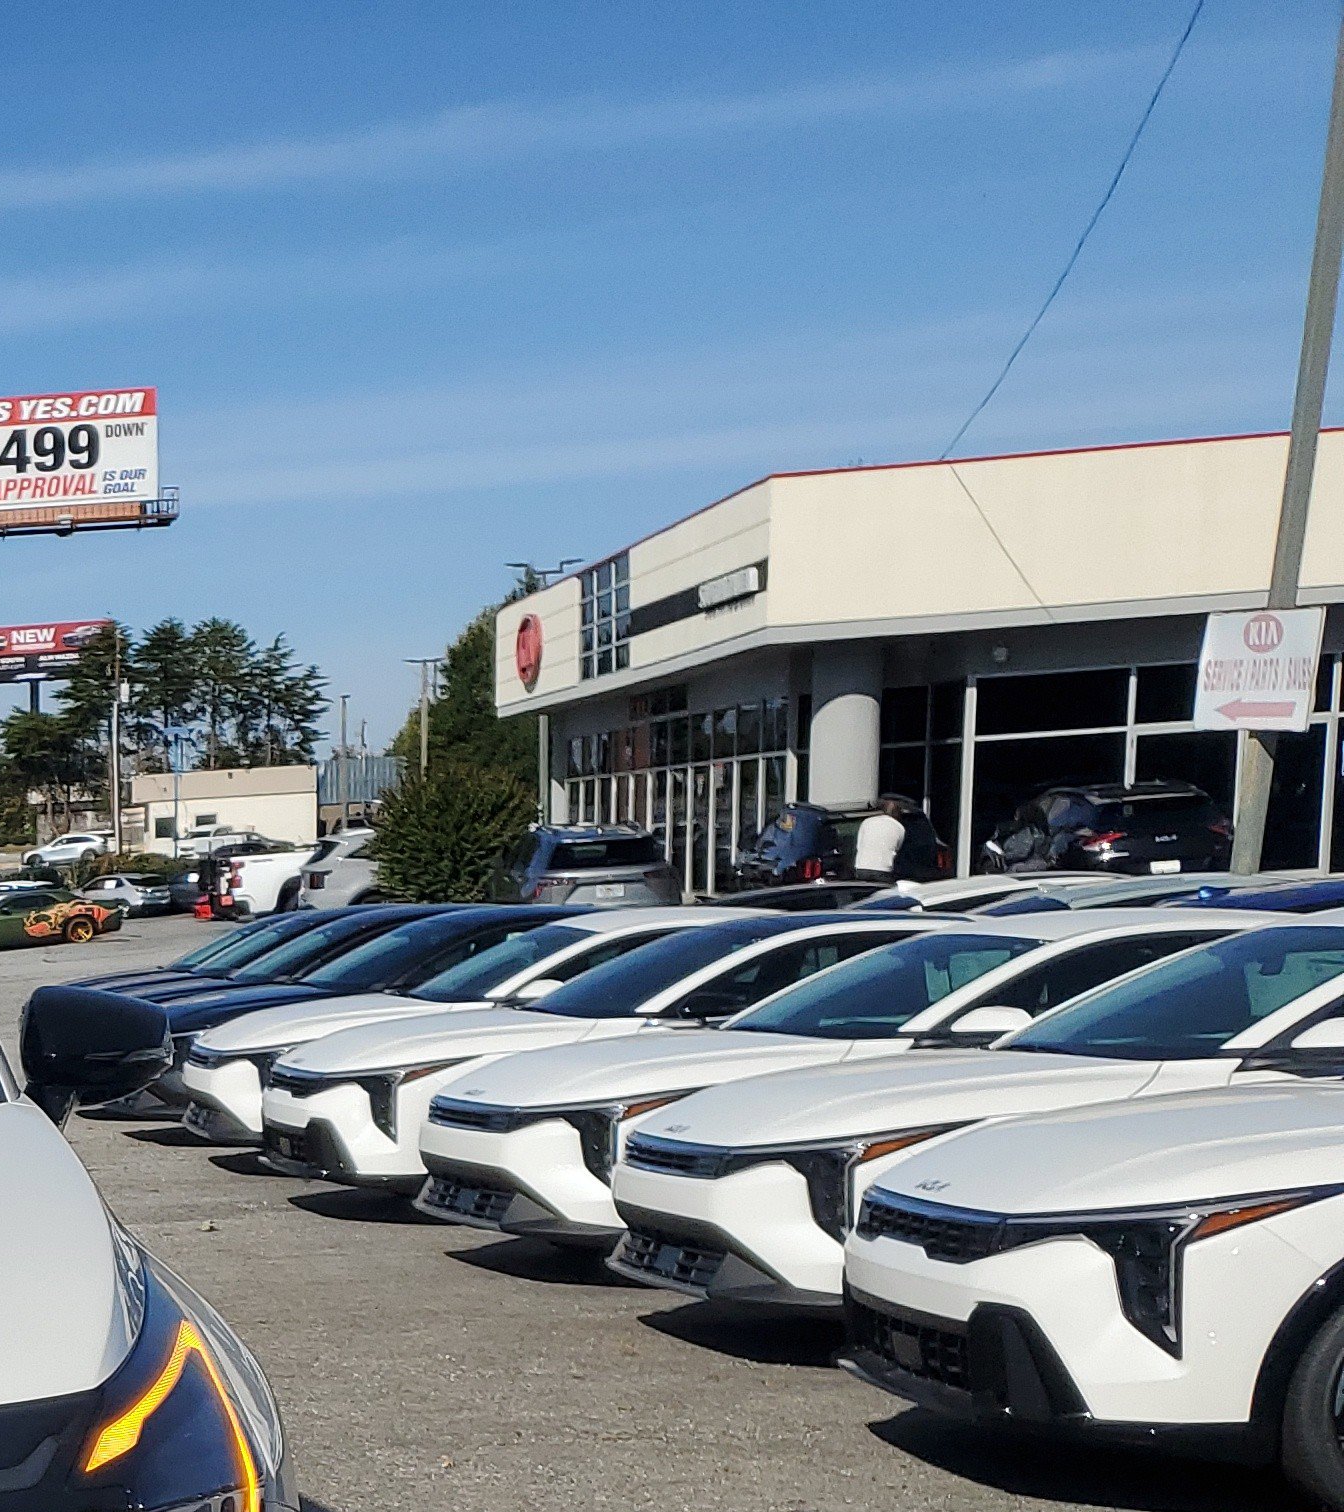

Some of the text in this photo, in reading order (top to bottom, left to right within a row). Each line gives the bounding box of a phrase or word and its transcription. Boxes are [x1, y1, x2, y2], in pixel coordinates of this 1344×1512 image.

[19, 392, 145, 421] YES.COM
[103, 468, 147, 482] IS OUR
[103, 482, 136, 495] GOAL
[12, 628, 56, 644] NEW
